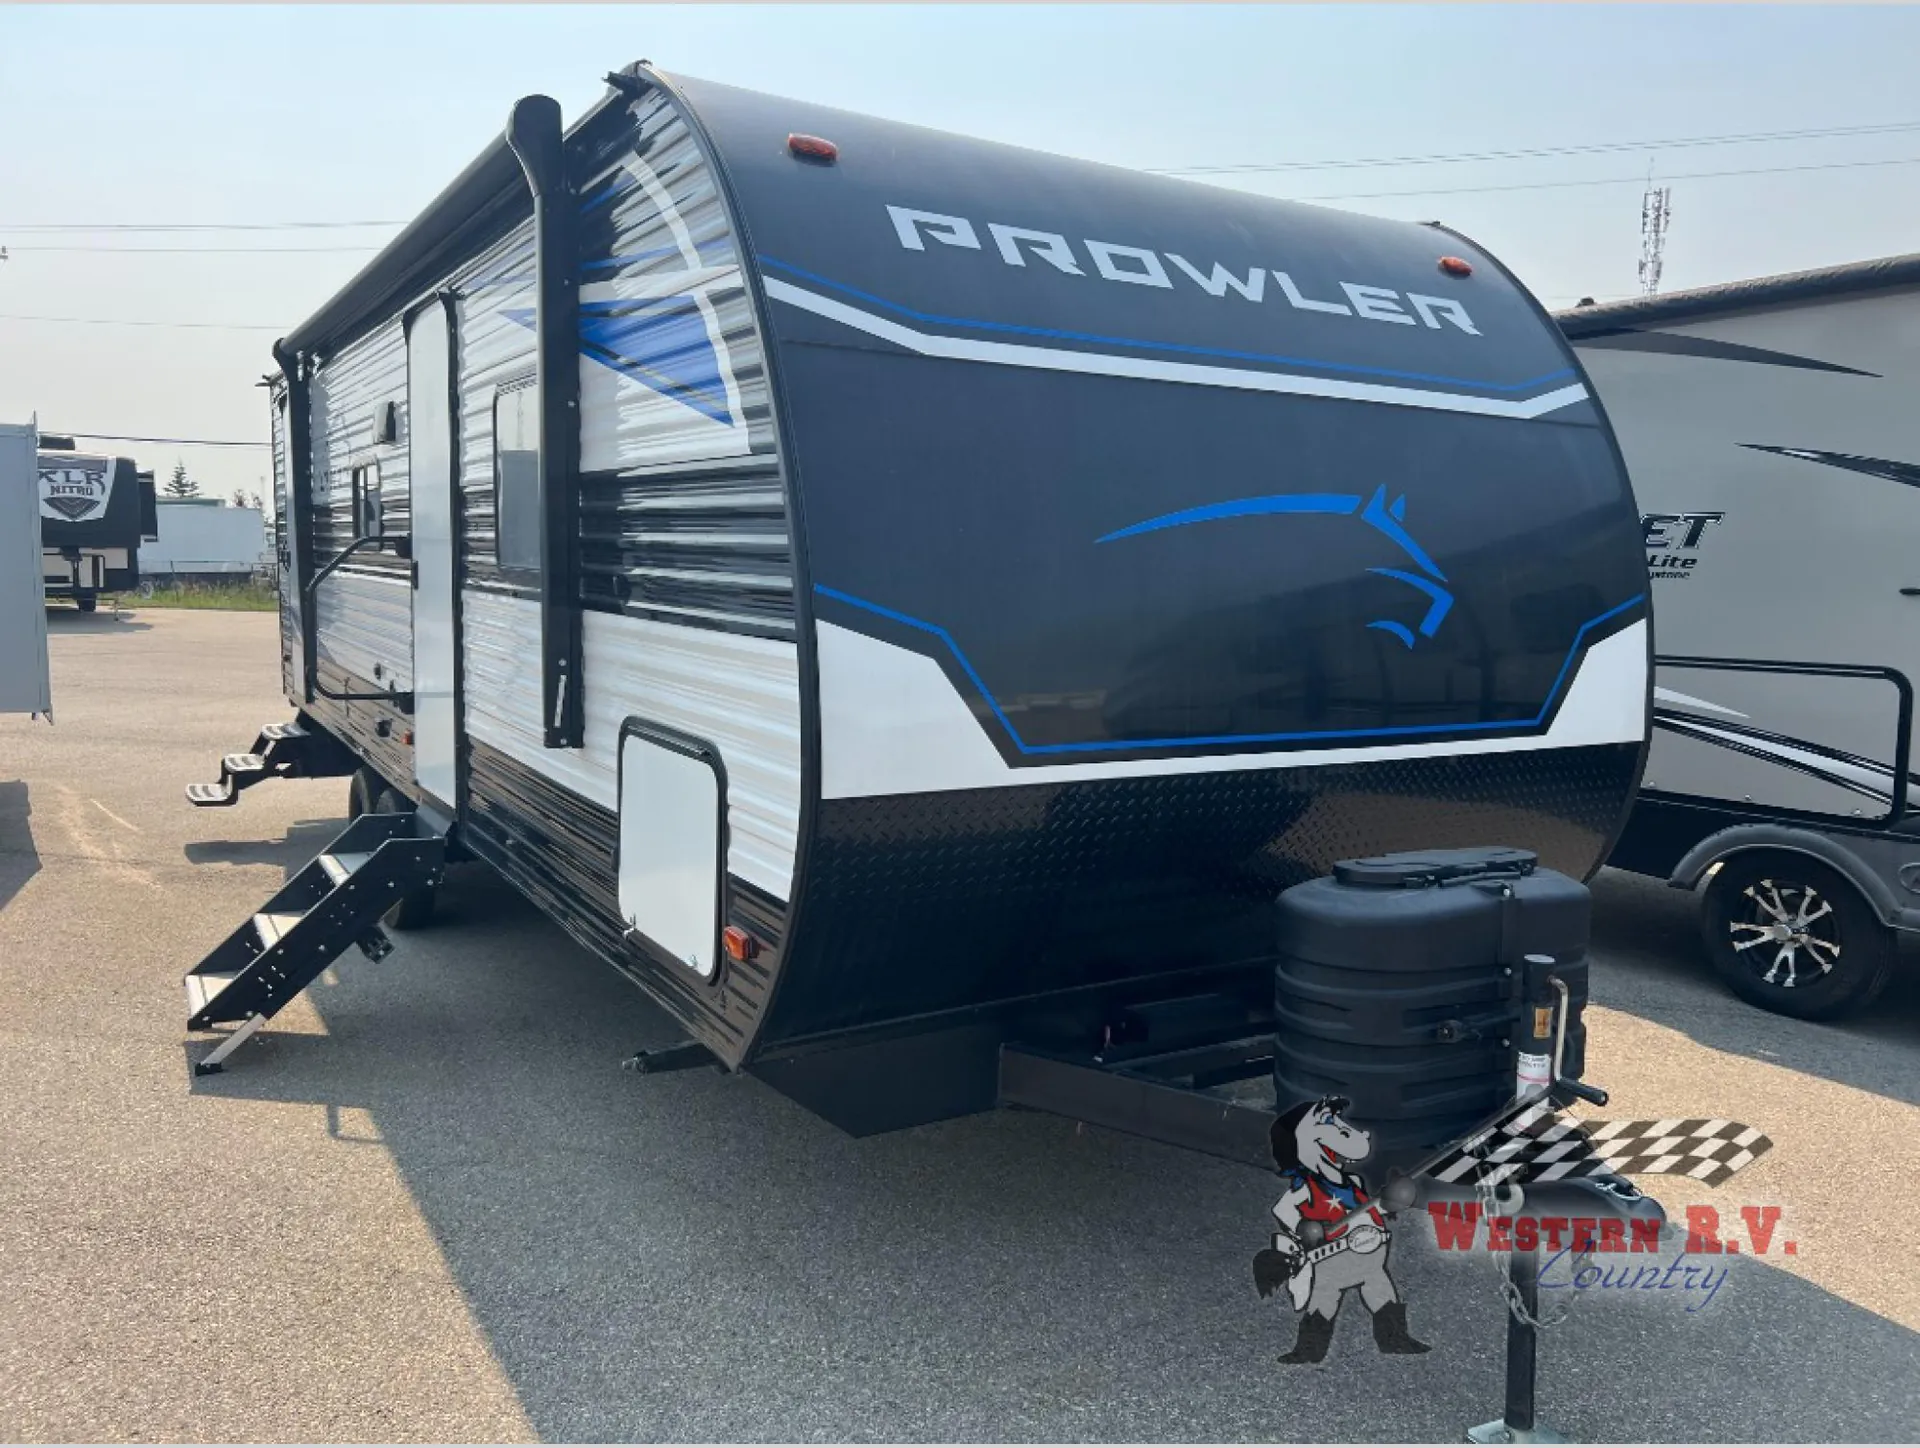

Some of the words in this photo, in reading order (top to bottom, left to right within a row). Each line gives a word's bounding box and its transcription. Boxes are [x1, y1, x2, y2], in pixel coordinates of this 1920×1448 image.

[885, 205, 1484, 336] PROWLER
[50, 486, 93, 495] NITRO
[1641, 512, 1726, 549] ET
[1648, 554, 1698, 569] Lite
